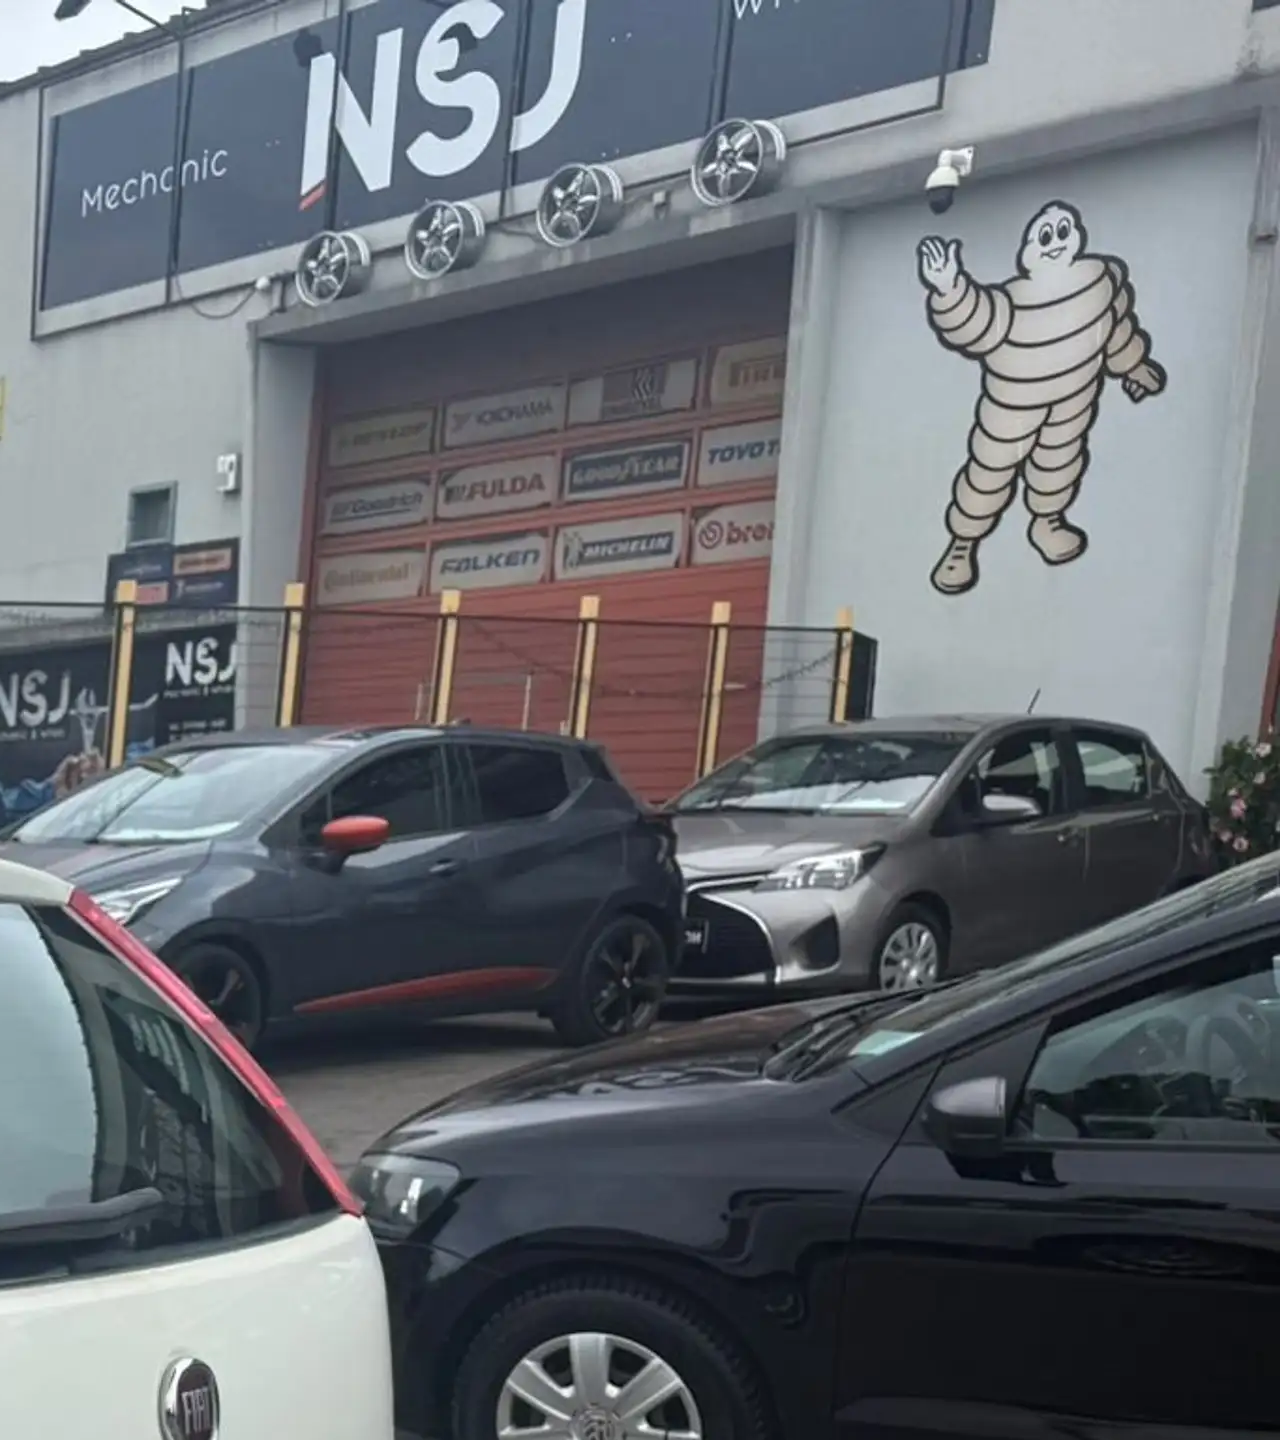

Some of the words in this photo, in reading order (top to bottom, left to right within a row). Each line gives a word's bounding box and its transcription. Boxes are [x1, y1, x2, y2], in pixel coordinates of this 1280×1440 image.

[299, 0, 587, 196] NSJ
[466, 473, 546, 500] FULDA
[583, 535, 671, 558] MICHELIN
[440, 548, 540, 576] FALKEN
